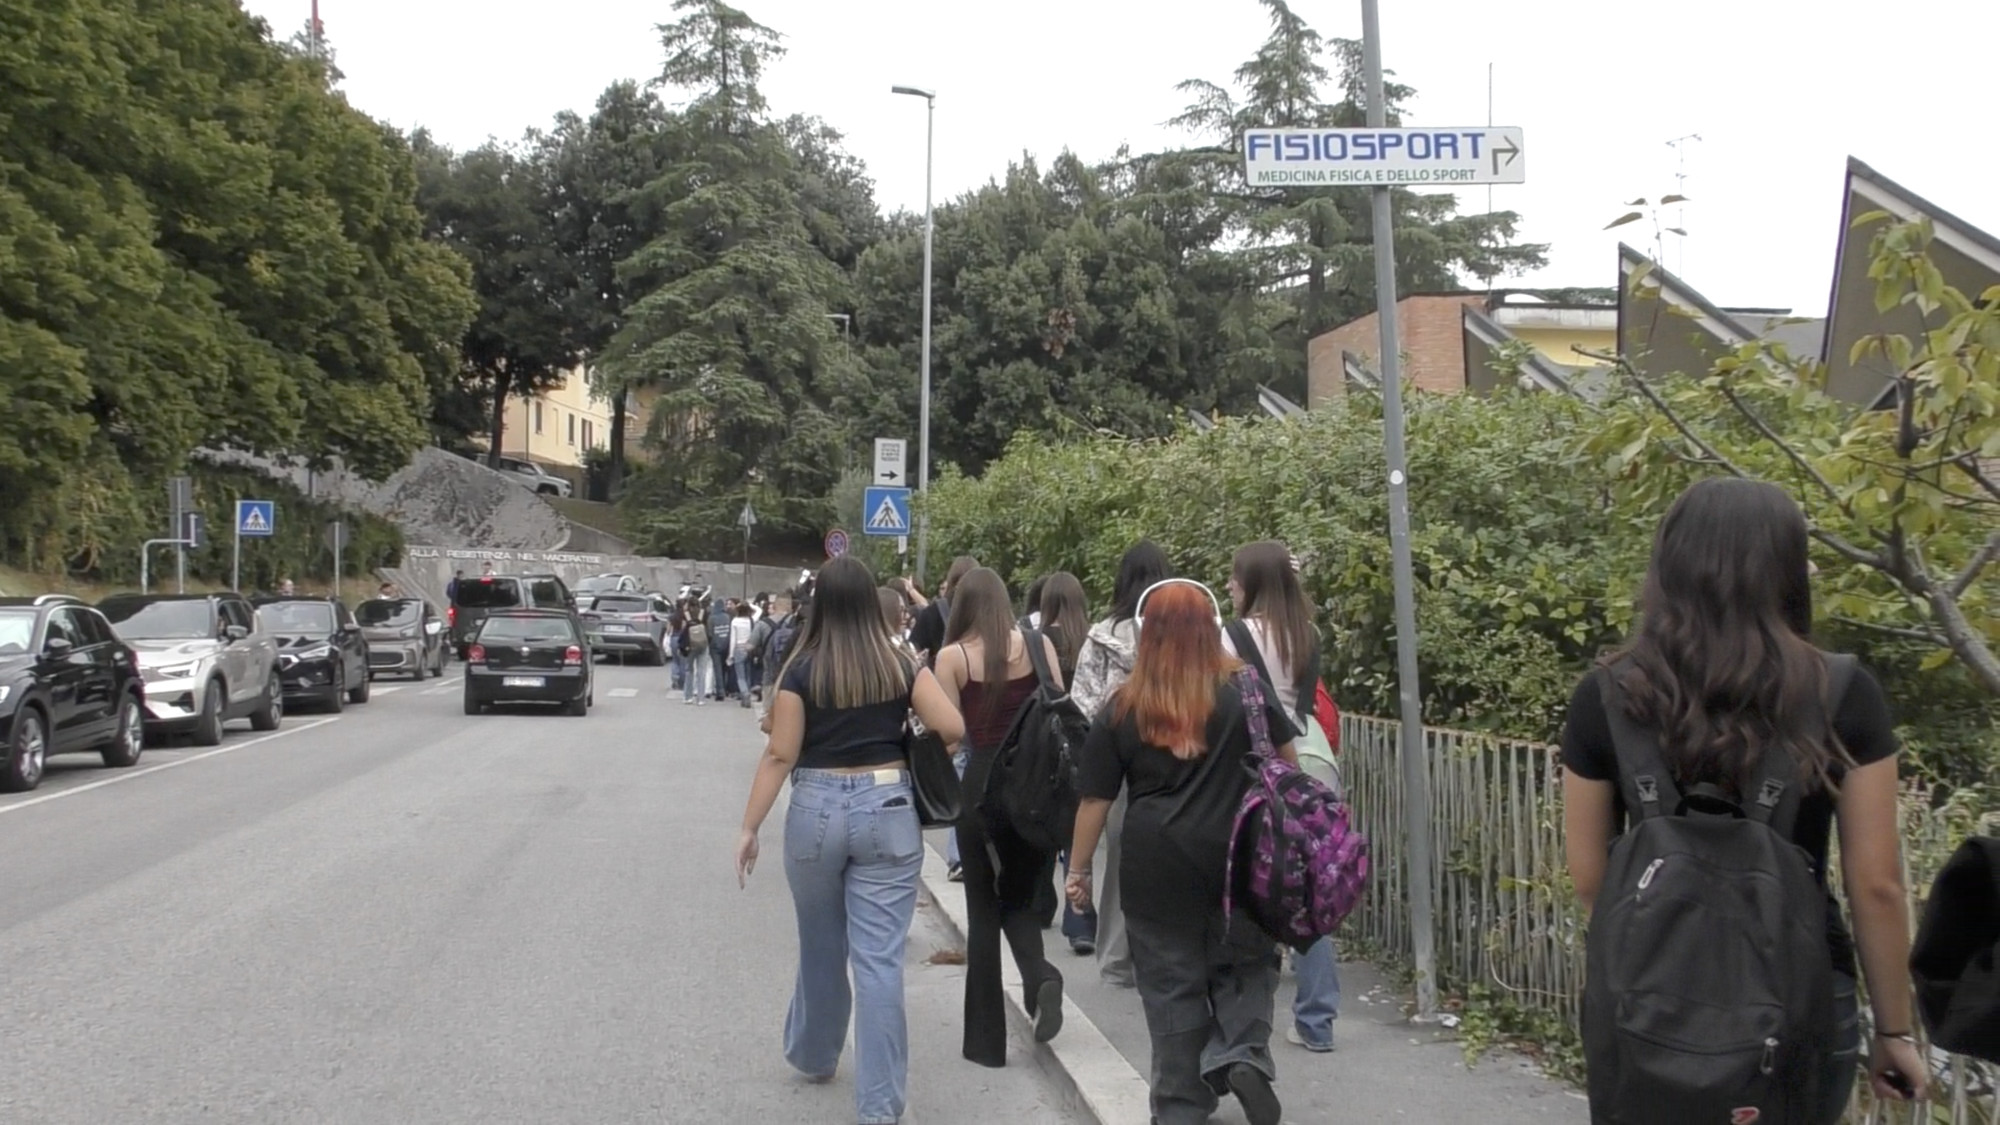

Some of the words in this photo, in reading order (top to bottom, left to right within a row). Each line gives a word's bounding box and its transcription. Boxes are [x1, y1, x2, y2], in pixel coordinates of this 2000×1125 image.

[1248, 132, 1486, 161] FISIOSPORT
[1258, 169, 1326, 182] MEDICINA
[1329, 169, 1372, 182] FISICA
[1376, 169, 1384, 181] E
[1387, 169, 1430, 181] DELLO
[1433, 168, 1476, 181] SPORT
[409, 548, 439, 558] ALLA
[446, 549, 512, 560] RESISTENZA
[517, 552, 538, 561] NEL
